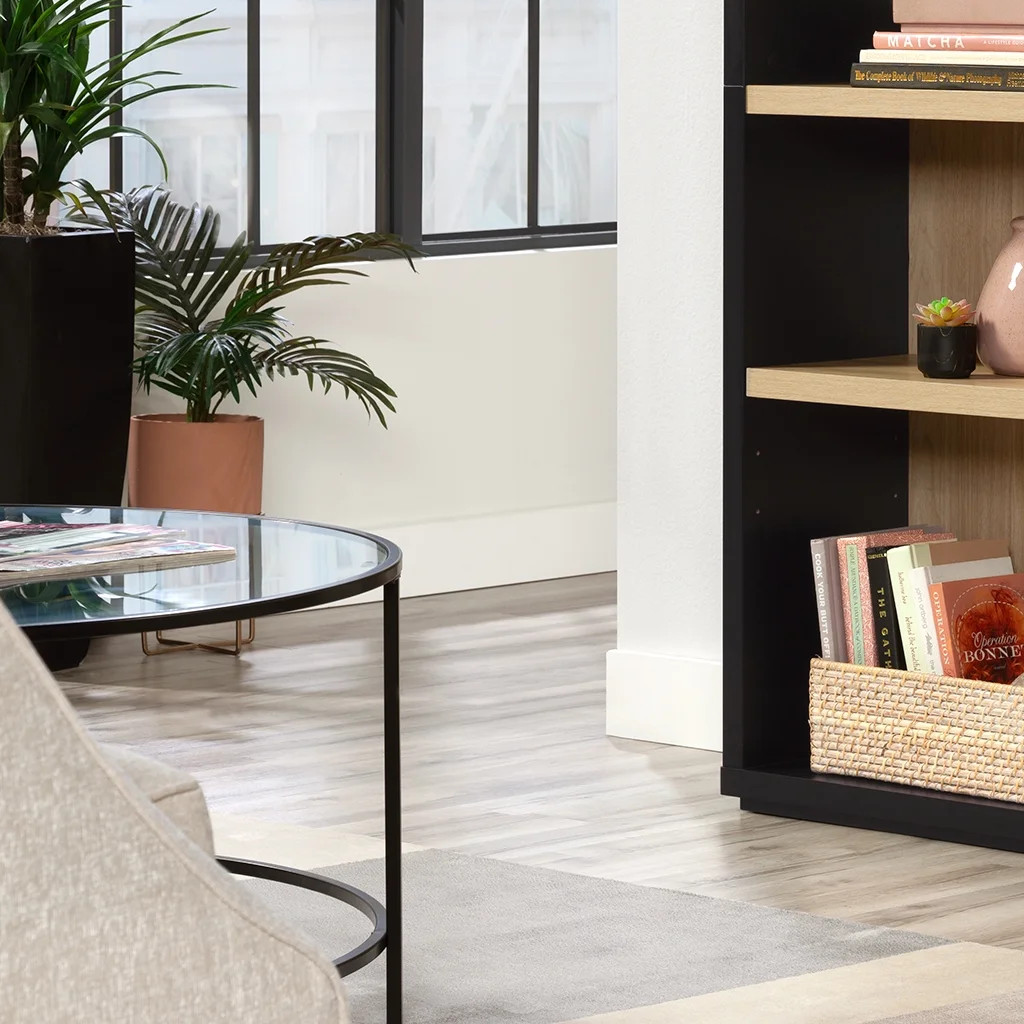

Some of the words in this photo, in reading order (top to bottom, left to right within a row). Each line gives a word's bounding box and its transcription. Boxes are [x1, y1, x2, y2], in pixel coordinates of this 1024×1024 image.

[887, 35, 965, 49] MATCHA
[855, 69, 865, 81] The
[866, 70, 892, 83] Complete
[892, 71, 907, 81] Book
[907, 71, 915, 81] of
[814, 553, 823, 579] COOK
[817, 581, 826, 607] YOUR
[877, 587, 887, 618] THE
[915, 587, 923, 603] john
[820, 609, 829, 634] BUTT
[933, 591, 950, 665] OPERATION
[971, 631, 1018, 650] Operation
